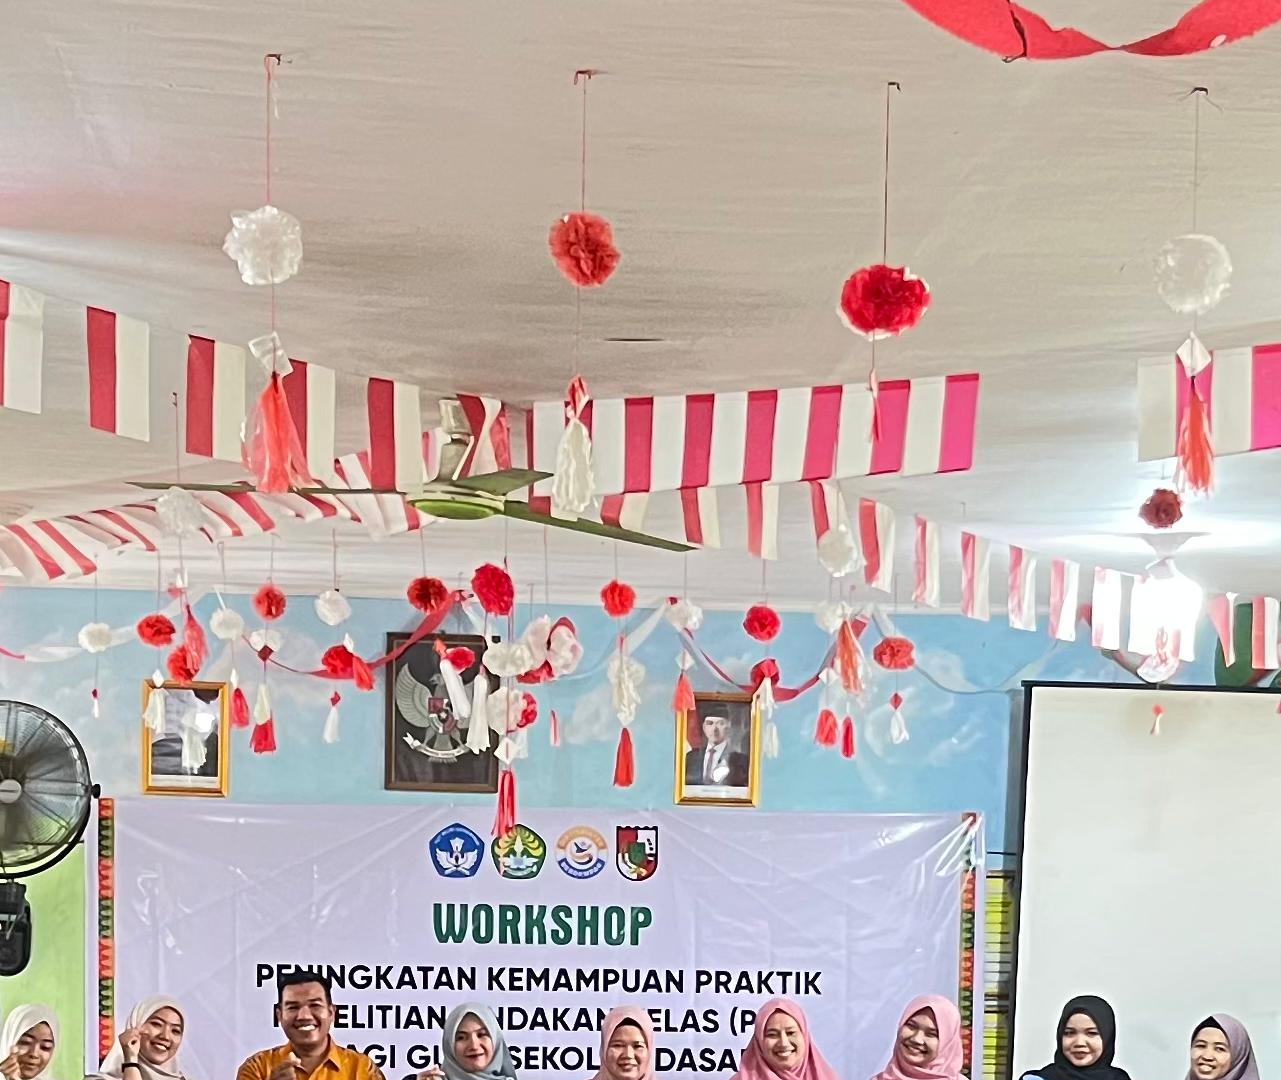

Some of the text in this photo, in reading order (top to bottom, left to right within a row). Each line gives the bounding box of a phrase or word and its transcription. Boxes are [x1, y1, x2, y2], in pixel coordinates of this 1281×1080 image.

[433, 902, 653, 947] WORKSHOP
[488, 967, 684, 994] KEMAMPUAN
[696, 970, 822, 995] PRAKTIK
[647, 1008, 720, 1034] ELAS
[655, 1047, 747, 1073] DASA
